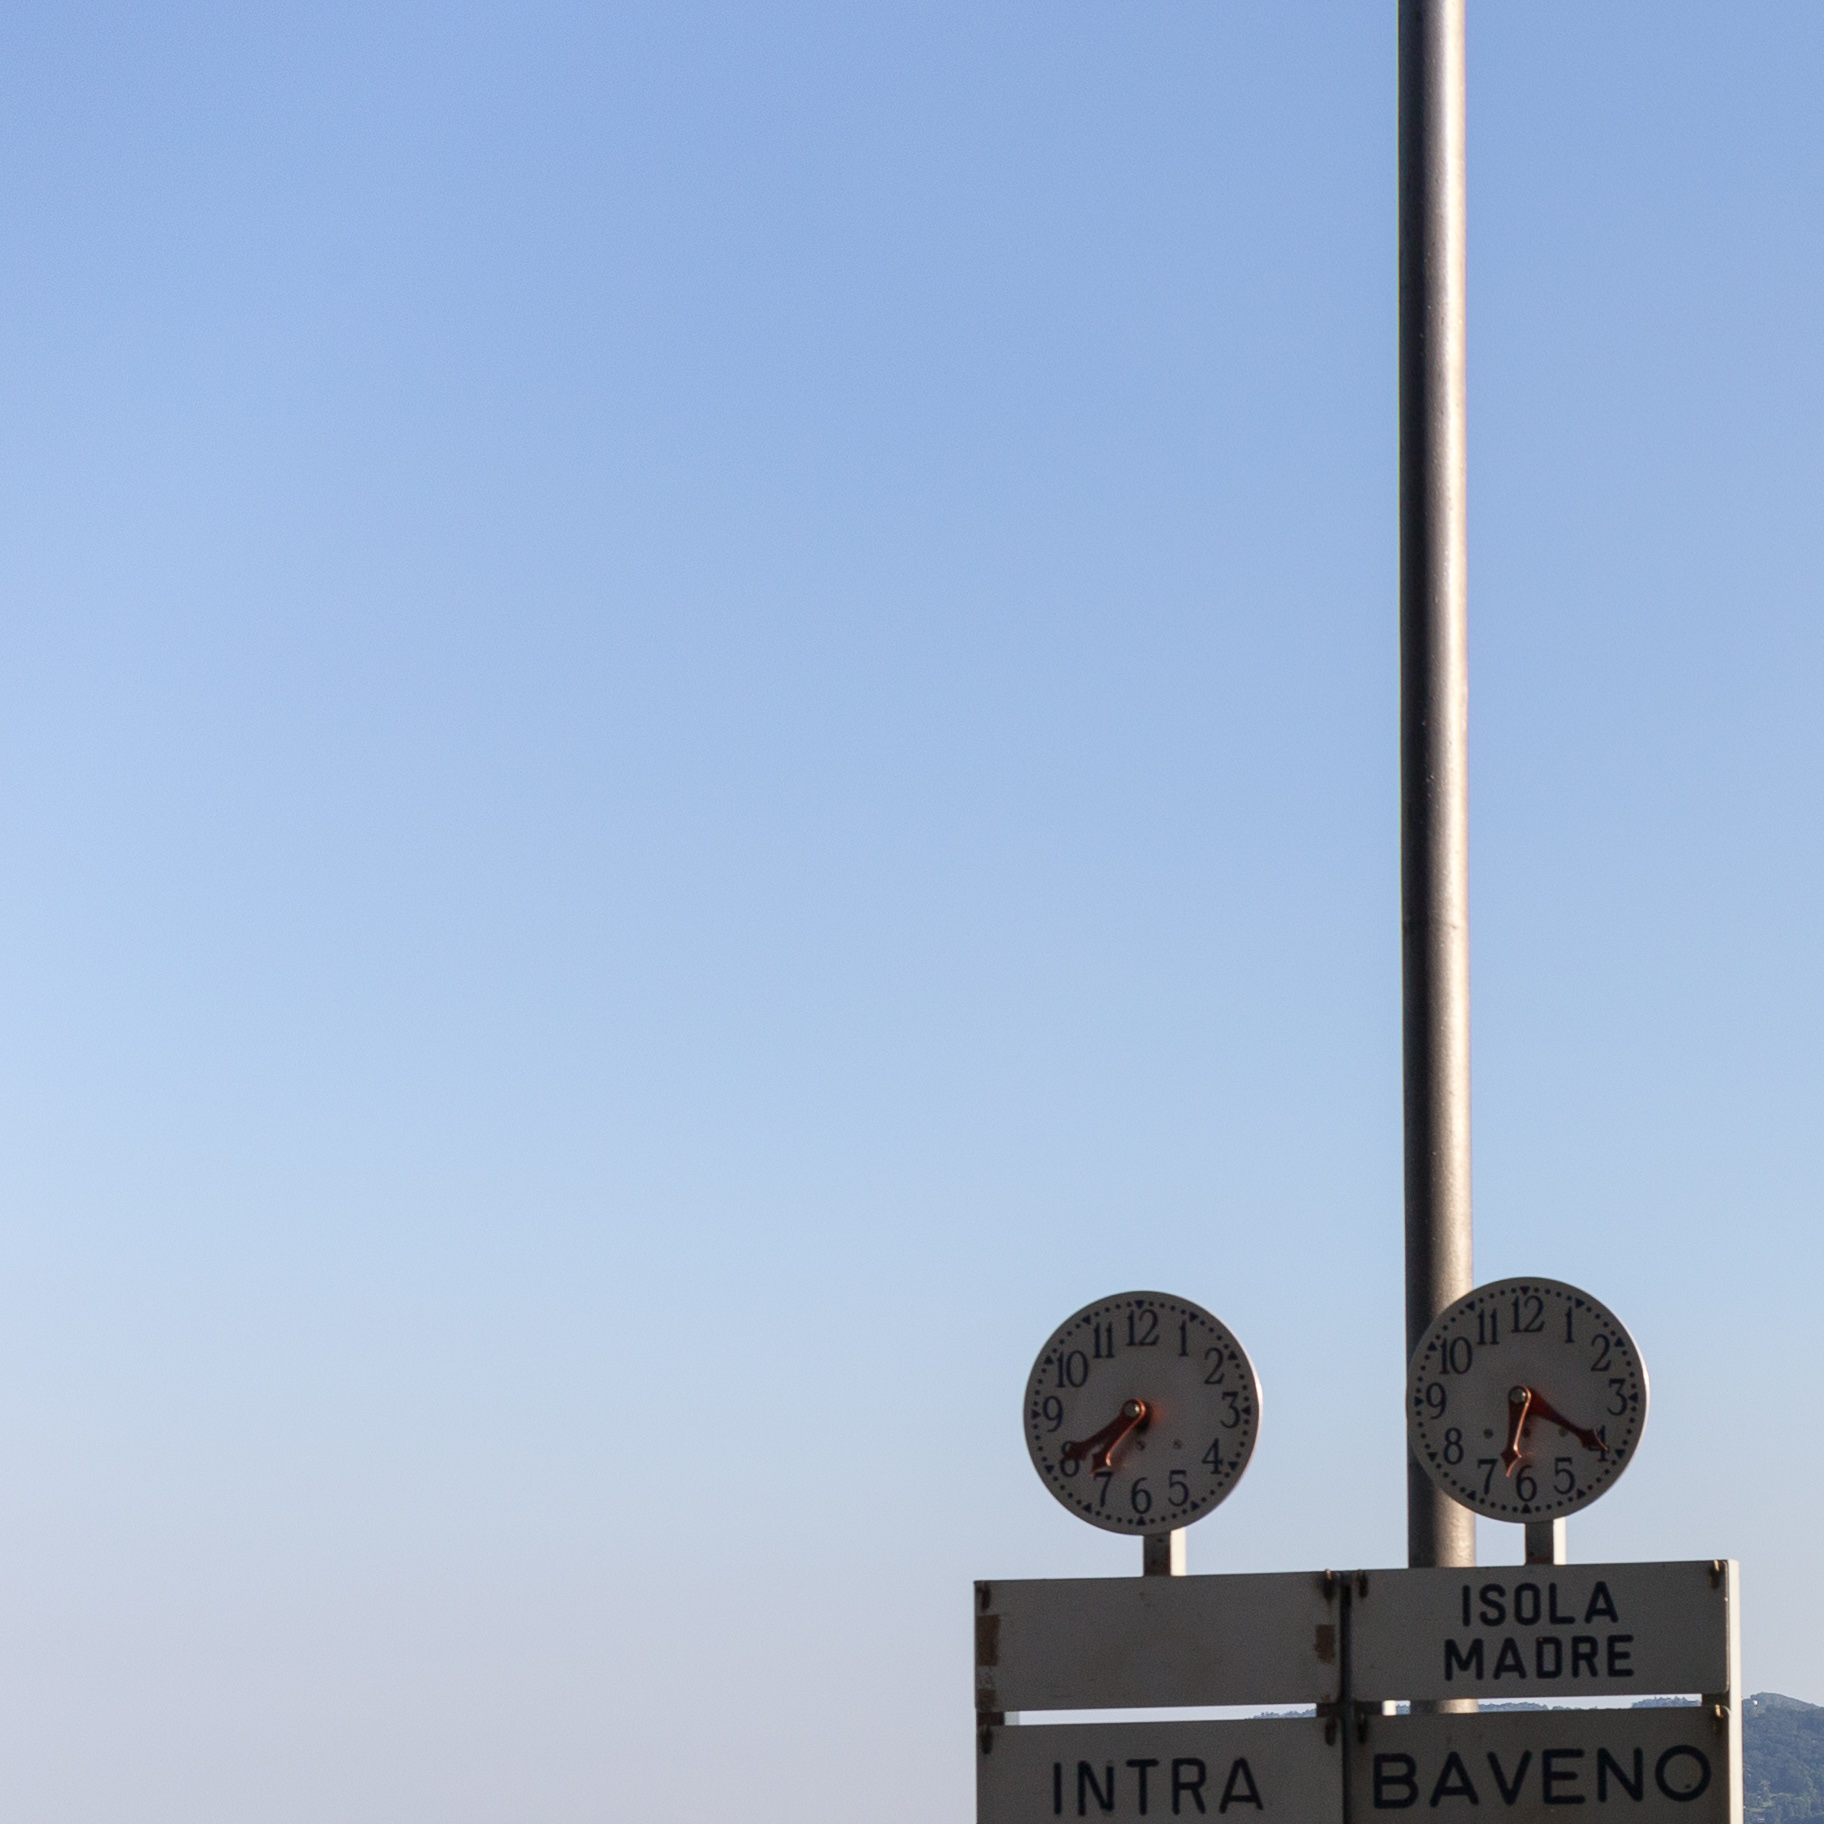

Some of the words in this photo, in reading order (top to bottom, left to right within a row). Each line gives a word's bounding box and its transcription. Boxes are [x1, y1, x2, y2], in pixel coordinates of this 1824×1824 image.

[1126, 1309, 1159, 1347] 12
[1477, 1308, 1500, 1345] 11
[1511, 1295, 1545, 1333] 12
[1564, 1306, 1575, 1343] 1
[1093, 1322, 1115, 1359] 11
[1179, 1319, 1189, 1357] 1
[1439, 1336, 1472, 1375] 10
[1590, 1334, 1612, 1372] 2
[1056, 1350, 1089, 1388] 10
[1204, 1347, 1225, 1385] 2
[1042, 1396, 1063, 1433] 9
[1220, 1391, 1241, 1428] 3
[1425, 1382, 1447, 1420] 9
[1607, 1378, 1628, 1416] 3
[1201, 1438, 1224, 1475] 4
[1443, 1428, 1464, 1465] 8
[1093, 1471, 1113, 1508] 7
[1167, 1469, 1189, 1507] 5
[1477, 1458, 1498, 1495] 7
[1515, 1465, 1537, 1502] 6
[1553, 1457, 1575, 1494] 5
[1130, 1477, 1151, 1515] 6
[1462, 1580, 1619, 1627] ISOLA
[1444, 1634, 1635, 1682] MADRE
[1053, 1757, 1264, 1817] INTRA
[1372, 1744, 1713, 1810] BAVENO
